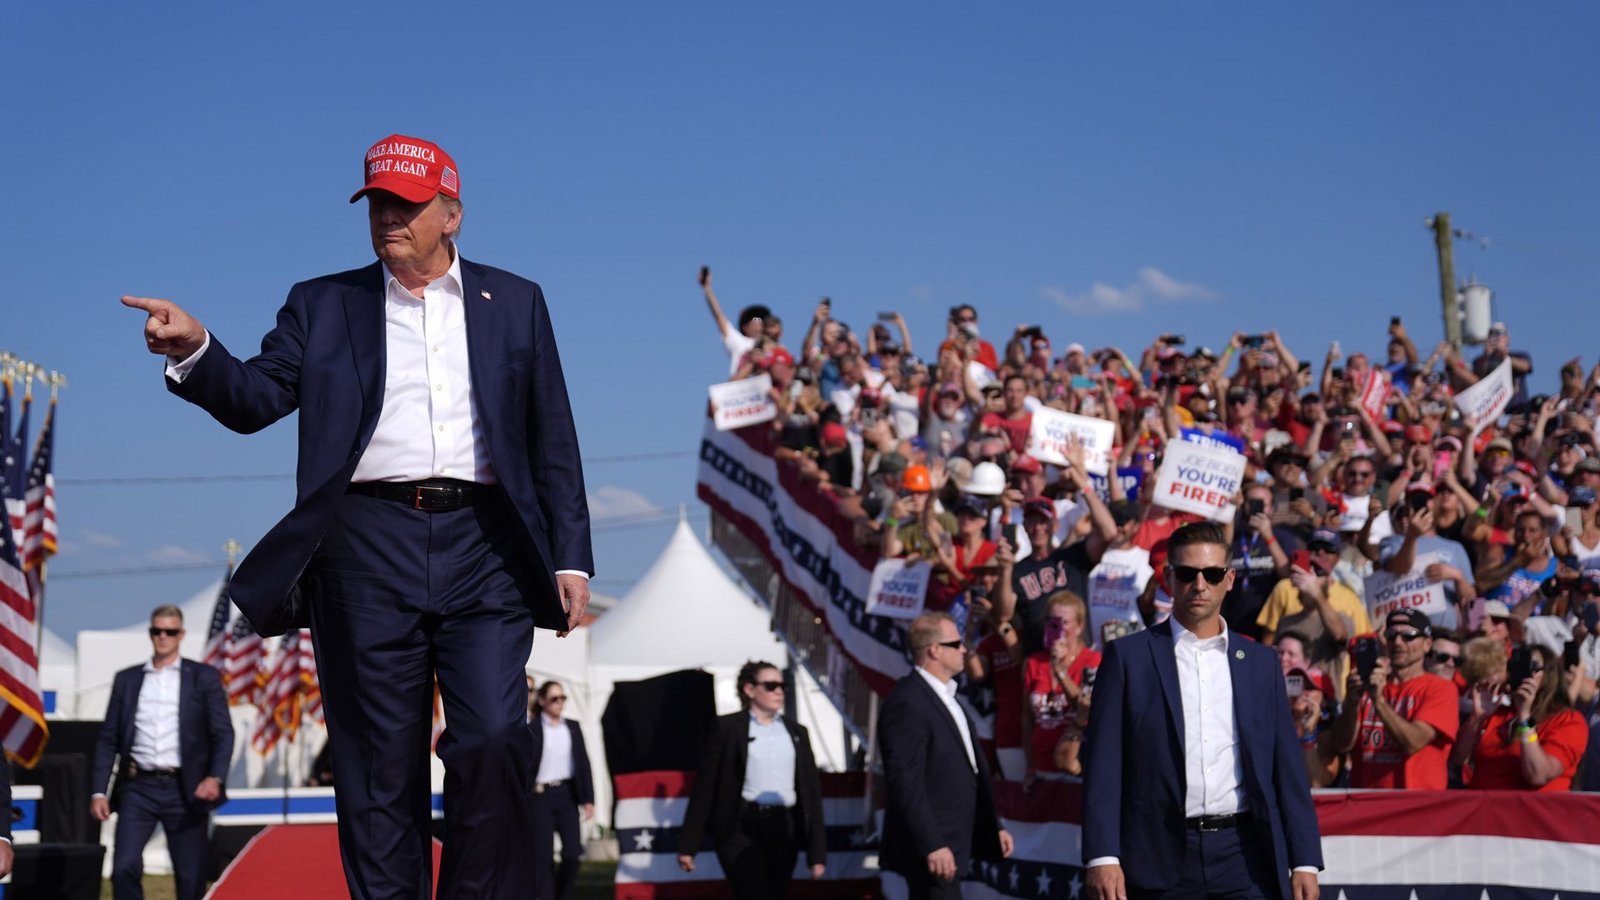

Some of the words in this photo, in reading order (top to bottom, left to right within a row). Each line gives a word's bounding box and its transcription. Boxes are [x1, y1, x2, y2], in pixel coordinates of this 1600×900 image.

[386, 142, 436, 164] AMERICA
[392, 160, 429, 178] AGAIN
[1177, 466, 1238, 493] YOU'RE
[1375, 577, 1425, 602] YOU'RE
[1374, 591, 1432, 618] FIRED!
